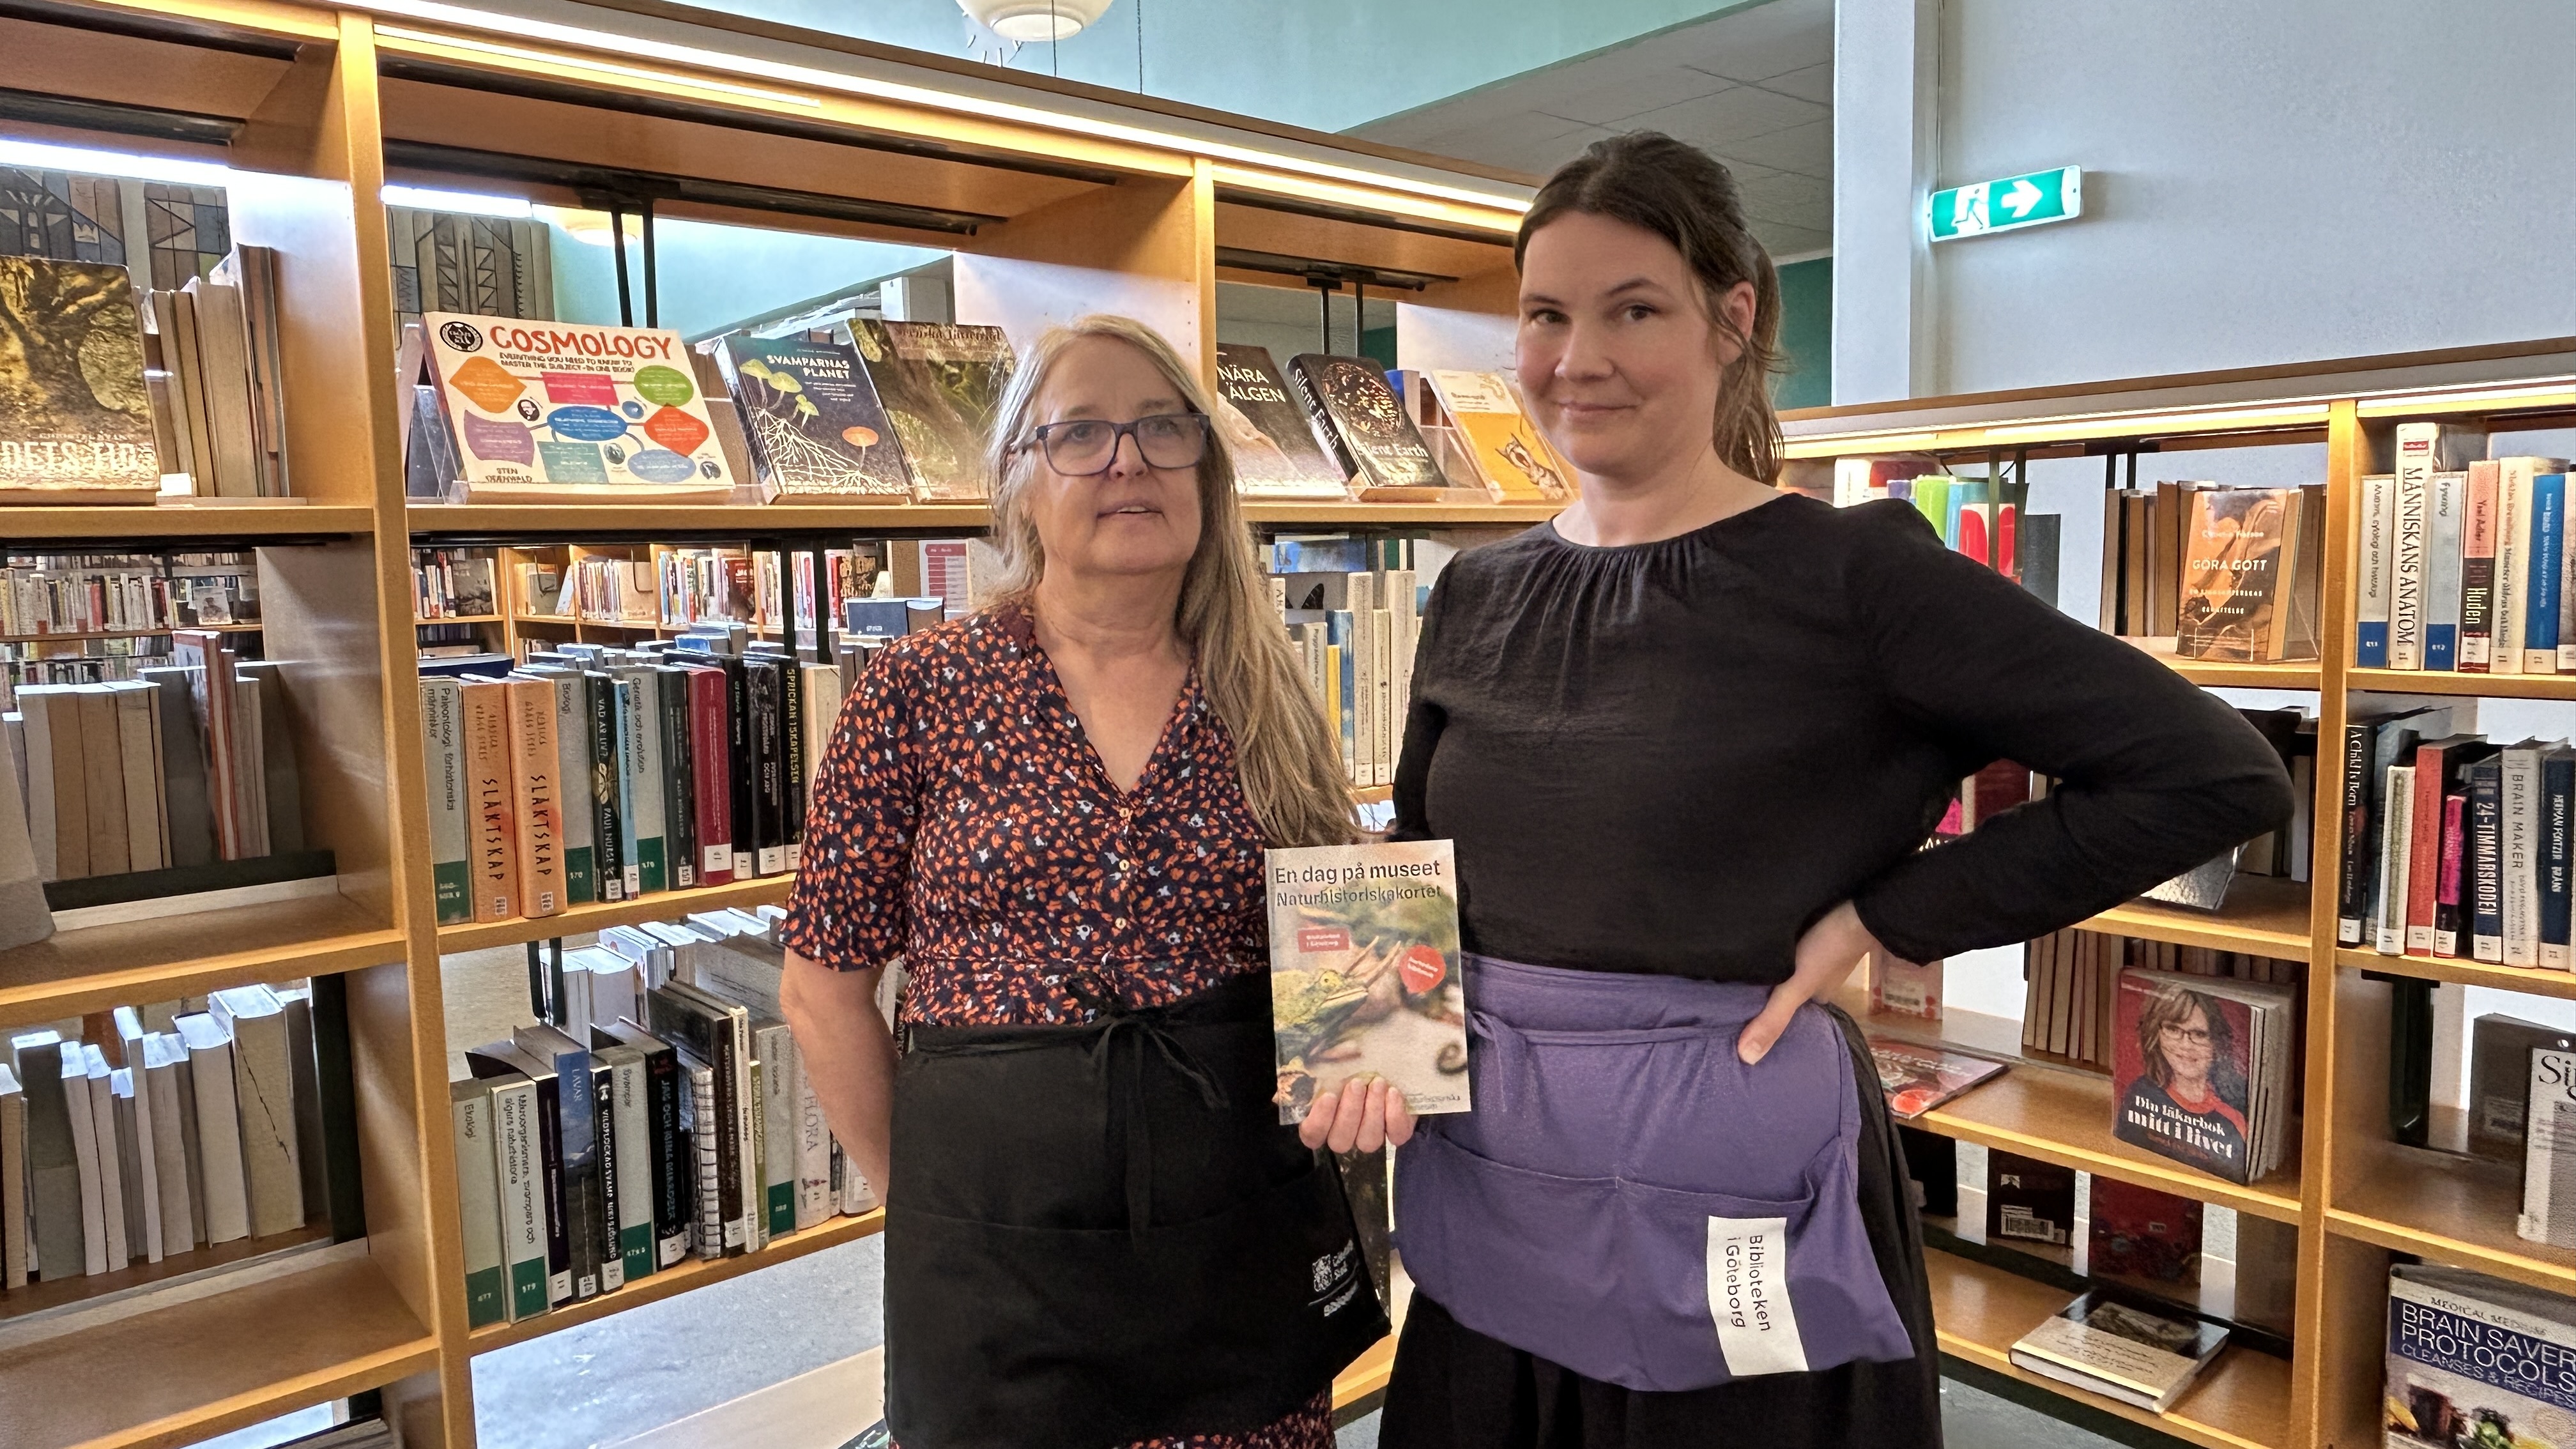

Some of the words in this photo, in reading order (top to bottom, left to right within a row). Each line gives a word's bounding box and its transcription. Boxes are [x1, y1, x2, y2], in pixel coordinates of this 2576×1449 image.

[490, 326, 671, 360] COSMOLOGY
[767, 355, 850, 369] SVAMPARNAS
[803, 367, 849, 379] PLANET
[1216, 364, 1269, 383] NÄRA
[1225, 382, 1286, 403] ÄLGEN
[1294, 368, 1317, 411] Silent
[1314, 408, 1340, 450] Earth
[1393, 443, 1429, 458] Earth
[2192, 558, 2228, 571] GÖRA
[2232, 560, 2267, 571] GOTT
[2465, 587, 2488, 625] Huden
[598, 698, 606, 717] VAD
[787, 668, 798, 719] SPRICKAN
[2350, 730, 2363, 738] A
[2349, 740, 2363, 768] Child
[2347, 781, 2361, 806] Born
[2511, 774, 2524, 815] BRAIN
[603, 808, 613, 829] PAUL
[2511, 822, 2524, 869] MAKER
[1275, 868, 1298, 884] En
[1302, 866, 1337, 884] dag
[1342, 862, 1365, 885] på
[1370, 860, 1441, 879] museet
[2538, 1055, 2576, 1087] Si
[804, 1095, 818, 1152] FLORA
[2135, 1095, 2159, 1114] Din
[2161, 1105, 2226, 1137] läkarbok
[2128, 1109, 2170, 1135] mitt
[2174, 1123, 2182, 1140] i
[2186, 1126, 2234, 1160] livet
[1726, 1244, 1746, 1328] Göteborg
[1749, 1234, 1771, 1331] Biblioteken
[2402, 1302, 2480, 1344] BRAIN
[2487, 1329, 2576, 1374] SAVER
[2400, 1343, 2484, 1379] CLEANSES
[2402, 1324, 2576, 1394] PROTOCOLS
